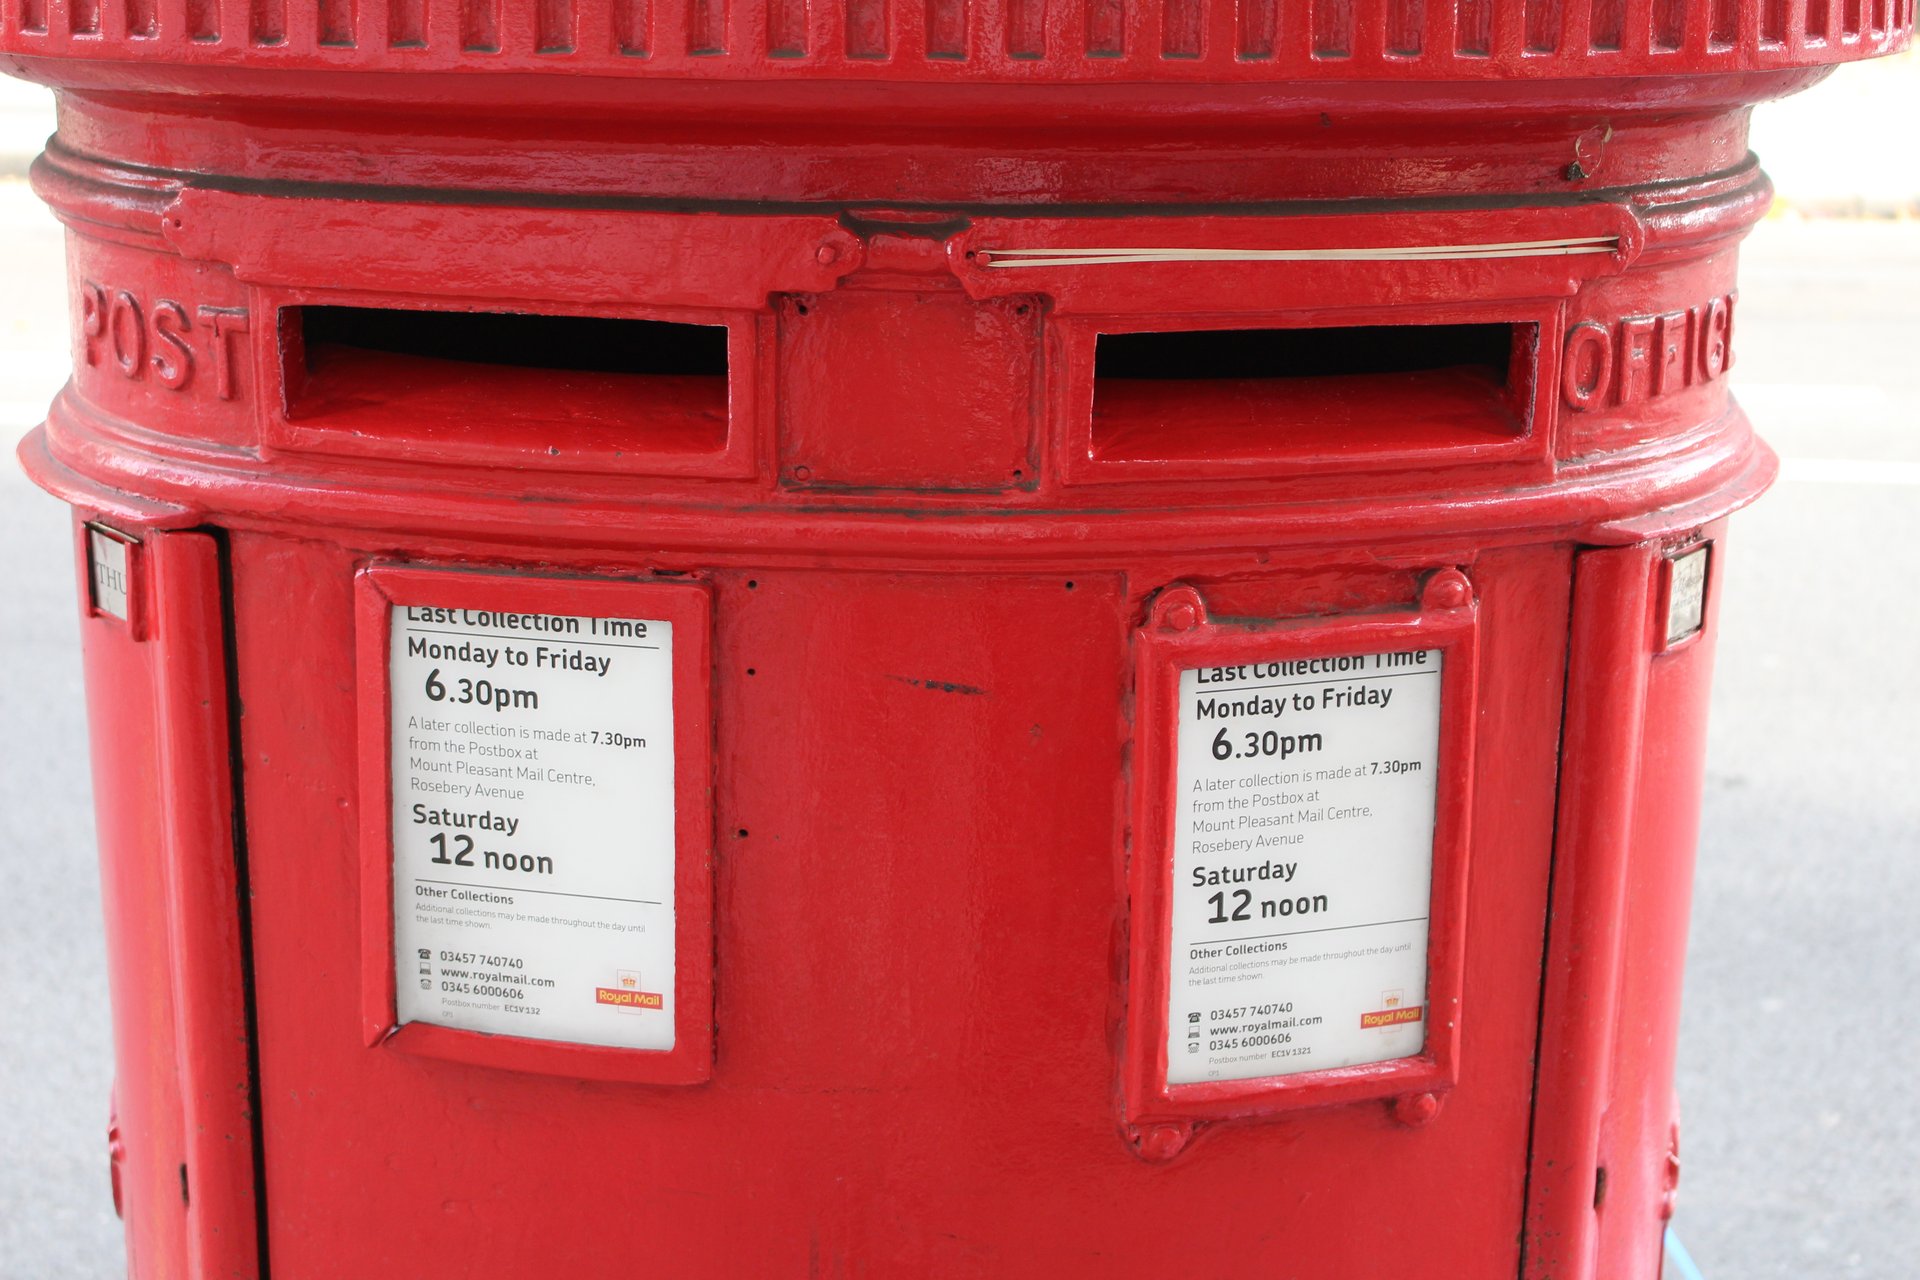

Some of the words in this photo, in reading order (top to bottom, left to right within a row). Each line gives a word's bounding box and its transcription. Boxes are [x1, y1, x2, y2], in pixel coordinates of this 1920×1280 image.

[83, 279, 250, 401] POST
[407, 606, 457, 624] Last
[464, 609, 579, 634] Collection
[589, 618, 648, 638] Time
[408, 636, 498, 668] Monday
[505, 646, 528, 666] to
[536, 647, 611, 677] Friday
[1198, 665, 1247, 684] Last
[1253, 656, 1364, 679] Collection
[1374, 650, 1427, 666] Time
[425, 668, 539, 712] 6.30pm
[1197, 695, 1286, 720] Monday
[1293, 692, 1316, 711] to
[1322, 685, 1392, 709] Friday
[408, 716, 418, 730] A
[420, 717, 450, 732] later
[454, 720, 516, 738] collection
[520, 726, 530, 739] is
[533, 726, 570, 742] made
[574, 731, 588, 743] at
[590, 731, 646, 750] 7.30pm
[1212, 727, 1322, 760] 6.30pm
[409, 736, 441, 751] from
[444, 740, 466, 754] the
[469, 742, 522, 758] Postbox
[525, 748, 538, 760] at
[410, 757, 453, 774] Mount
[456, 760, 513, 779] Pleasant
[516, 767, 544, 782] Mail
[548, 769, 596, 787] Centre,
[1193, 780, 1202, 792] A
[1206, 778, 1236, 791] later
[1239, 770, 1299, 788] collection
[1303, 769, 1312, 782] is
[1316, 766, 1351, 781] made
[1354, 766, 1367, 776] at
[1370, 760, 1422, 776] 7.30pm
[411, 778, 472, 798] Rosebery
[474, 784, 524, 800] Avenue
[1193, 800, 1224, 813] from
[1228, 796, 1248, 810] the
[1252, 791, 1304, 807] Postbox
[1306, 790, 1320, 802] at
[412, 804, 519, 836] Saturday
[1193, 818, 1235, 833] Mount
[1238, 811, 1294, 829] Pleasant
[1298, 808, 1324, 822] Mail
[1328, 805, 1372, 820] Centre,
[430, 832, 474, 866] 12
[484, 849, 553, 874] noon
[1192, 838, 1252, 854] Rosebery
[1256, 832, 1304, 848] Avenue
[1192, 860, 1298, 887] Saturday
[415, 885, 448, 898] Other
[450, 888, 514, 905] Collections
[1208, 888, 1252, 924] 12
[1261, 894, 1328, 918] noon
[416, 902, 454, 914] Additional
[456, 906, 496, 918] collections
[498, 912, 514, 922] may
[516, 912, 526, 922] be
[528, 914, 550, 924] made
[552, 916, 595, 929] throughout
[597, 920, 610, 930] the
[612, 922, 626, 933] day
[628, 922, 646, 934] until
[416, 914, 429, 924] the
[430, 916, 444, 925] last
[446, 917, 463, 927] time
[440, 950, 476, 964] 03457
[480, 954, 523, 968] 740740
[1189, 962, 1228, 974] Additional
[1229, 960, 1270, 971] collections
[1271, 958, 1287, 968] may
[1289, 956, 1298, 964] be
[1300, 953, 1322, 963] made
[1322, 948, 1364, 962] throughout
[1366, 946, 1378, 955] the
[1380, 945, 1394, 956] day
[1394, 942, 1412, 952] until
[1190, 947, 1223, 960] Other
[1226, 941, 1288, 956] Collections
[440, 968, 555, 987] www.royalmail.com
[1188, 977, 1202, 986] the
[1203, 976, 1216, 985] last
[1218, 974, 1236, 984] time
[442, 982, 470, 993] 0345
[474, 985, 524, 999] 6000606
[599, 990, 632, 1004] Royal
[634, 992, 660, 1006] Mail
[442, 998, 470, 1008] Postbox
[472, 1002, 500, 1010] number
[1210, 1008, 1246, 1020] 03457
[1250, 1002, 1293, 1017] 740740
[1210, 1016, 1322, 1036] www.royalmail.com
[1364, 1012, 1394, 1026] Royal
[1396, 1008, 1419, 1022] Mail
[1210, 1038, 1238, 1051] 0345
[1242, 1032, 1292, 1048] 6000606
[1208, 1056, 1238, 1064] Postbox
[1239, 1054, 1266, 1062] number
